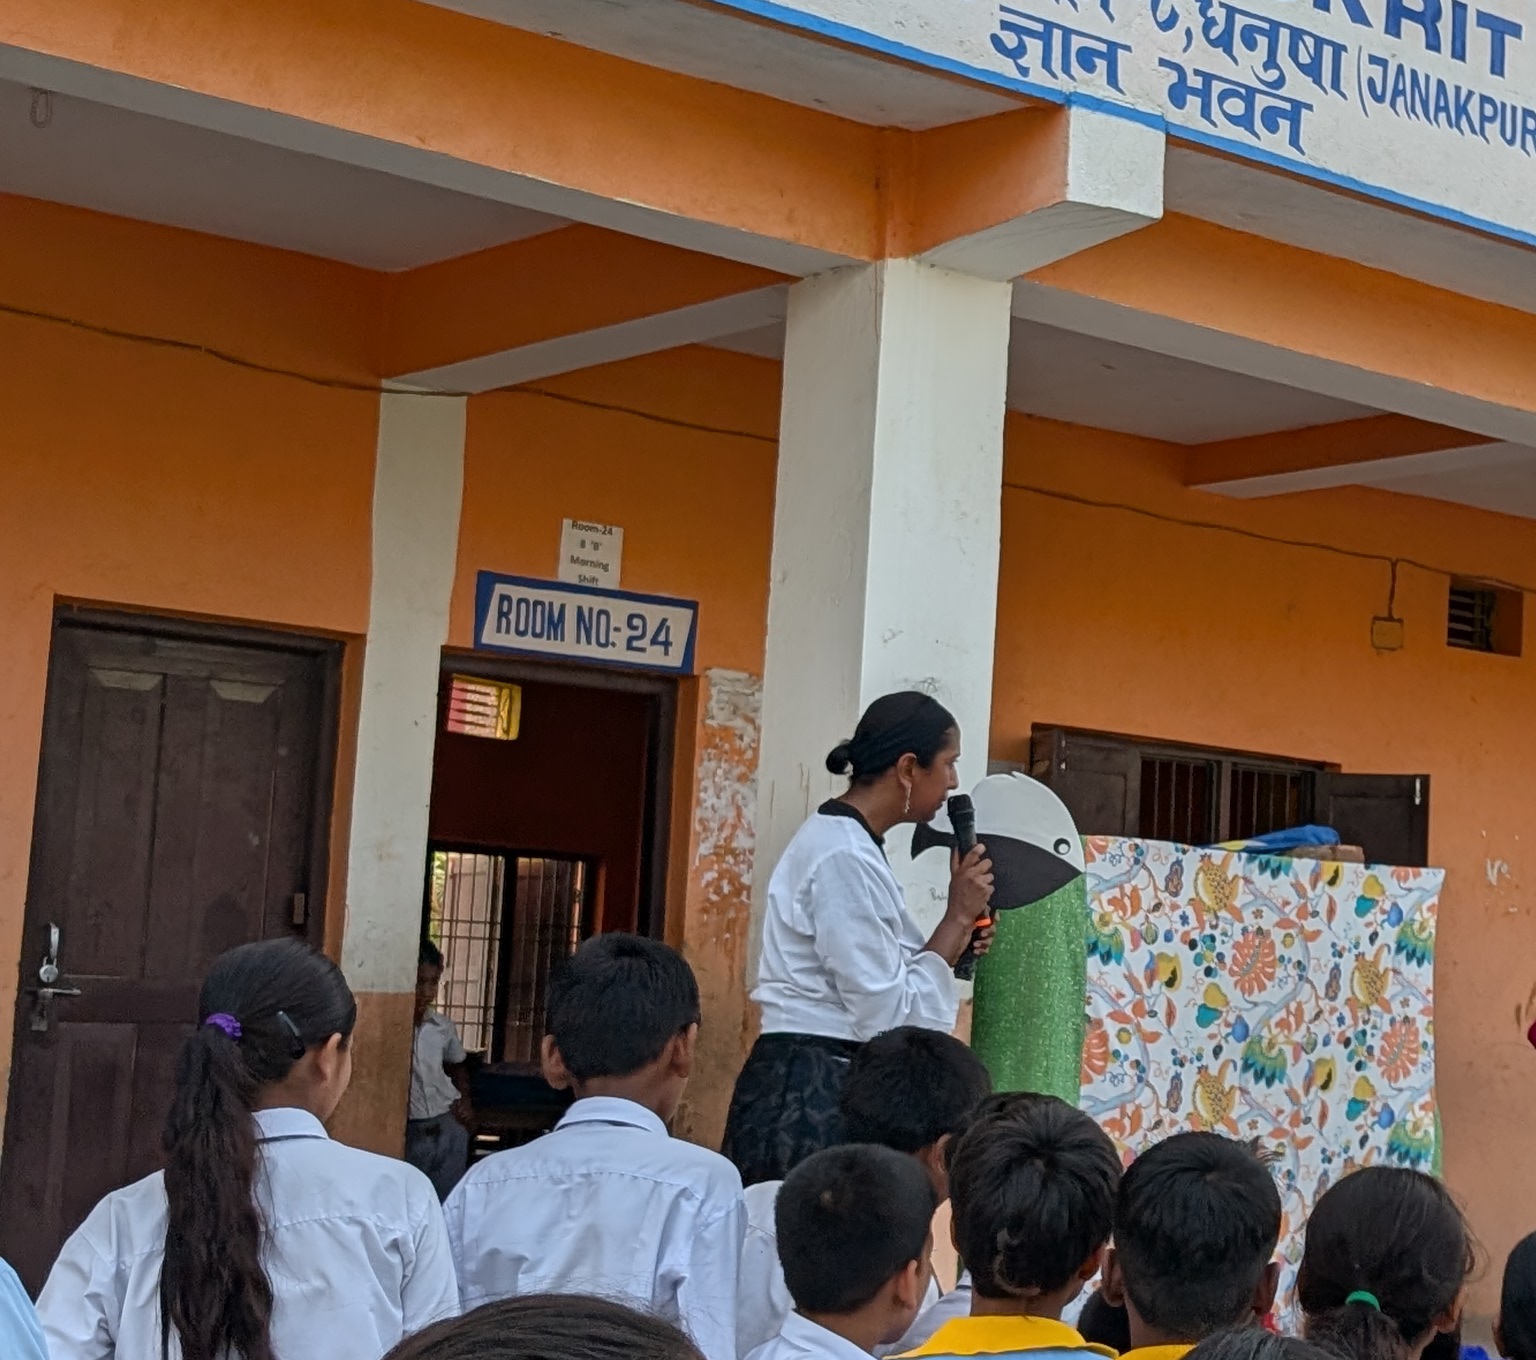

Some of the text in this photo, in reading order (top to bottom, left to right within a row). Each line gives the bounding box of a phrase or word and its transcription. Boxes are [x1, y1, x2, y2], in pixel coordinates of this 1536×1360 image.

[990, 5, 1314, 156] ज्ञान भवन
[570, 554, 609, 572] Morning
[578, 574, 599, 586] Shift
[495, 593, 566, 642] ROOM
